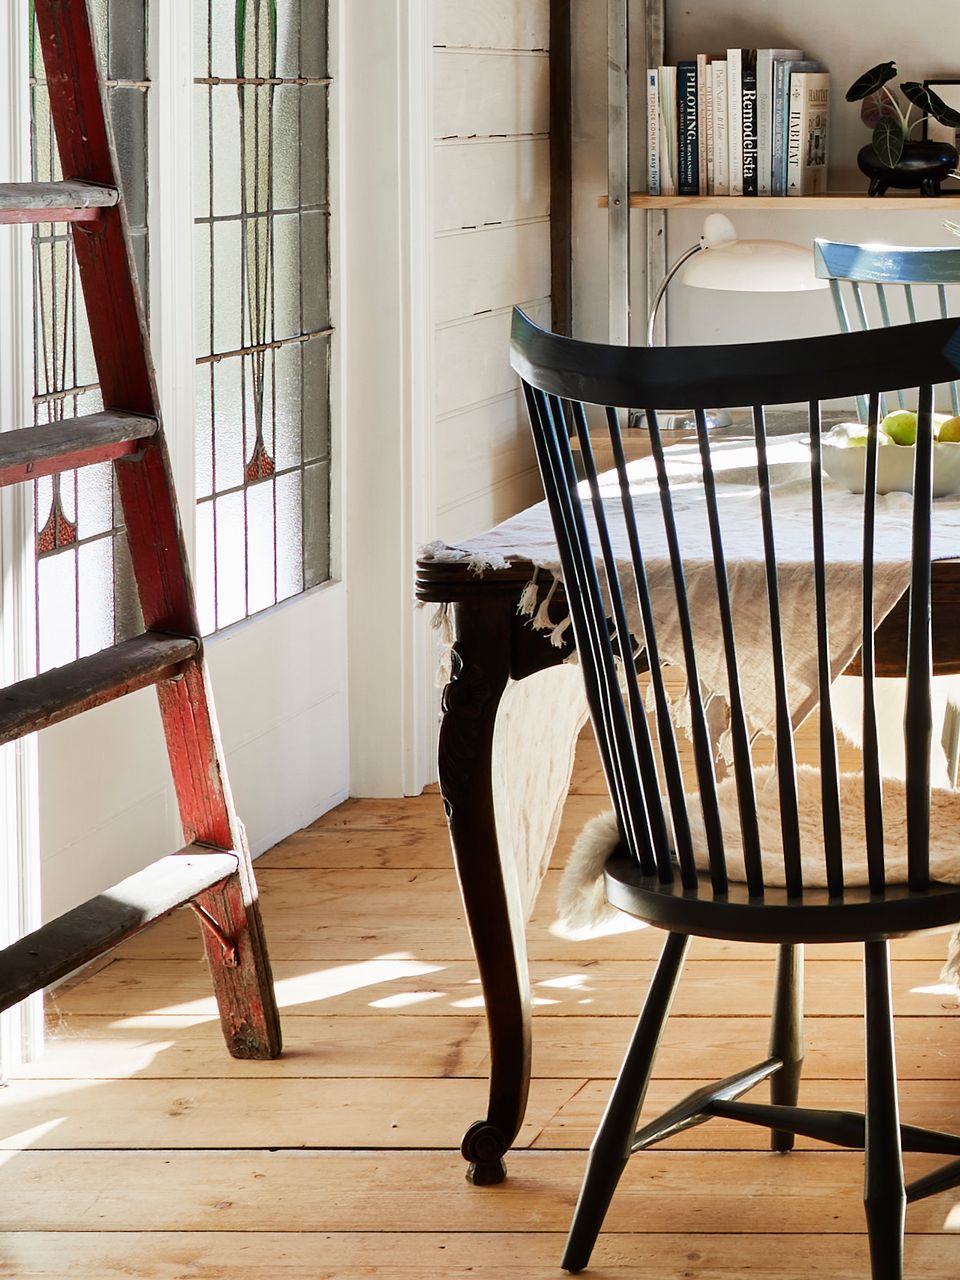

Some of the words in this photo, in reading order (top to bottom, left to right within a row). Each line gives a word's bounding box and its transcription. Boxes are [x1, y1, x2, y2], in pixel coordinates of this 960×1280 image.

[686, 72, 696, 143] PILOTING,
[743, 89, 758, 179] Remodelista
[789, 111, 801, 166] HABITAT
